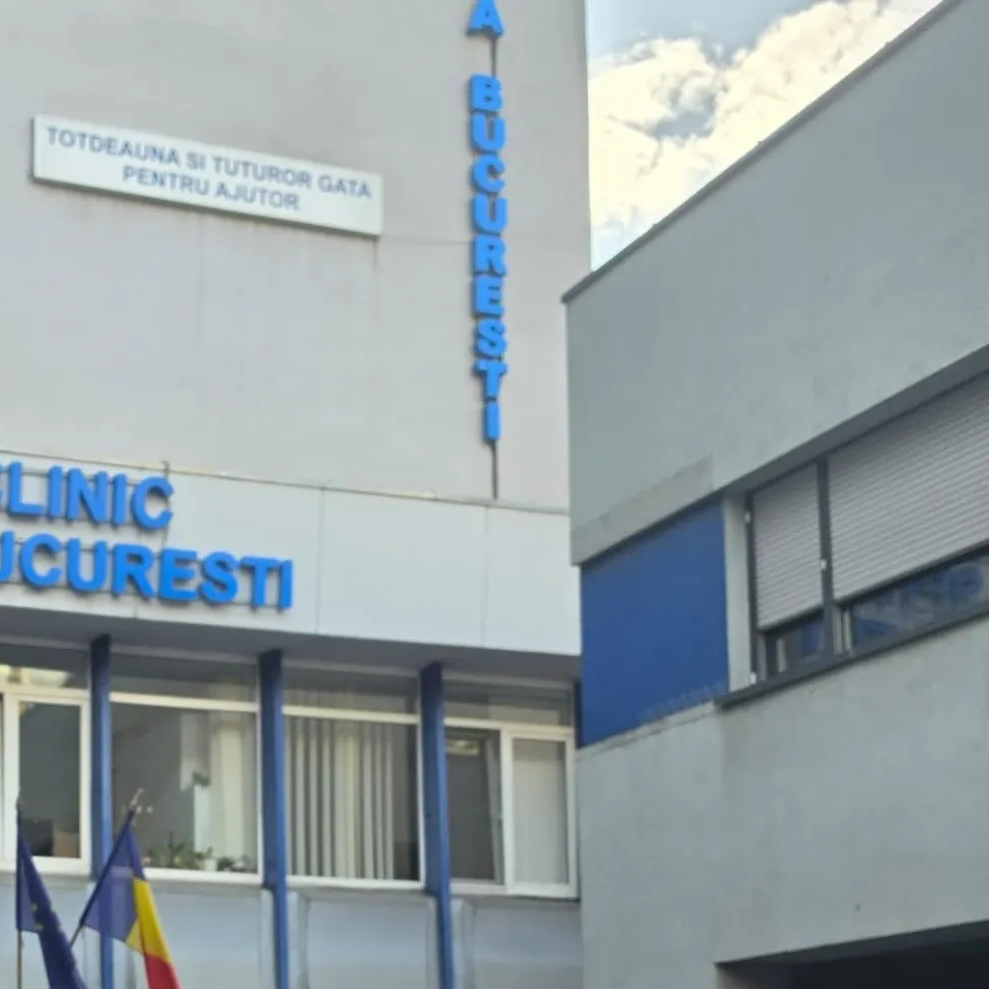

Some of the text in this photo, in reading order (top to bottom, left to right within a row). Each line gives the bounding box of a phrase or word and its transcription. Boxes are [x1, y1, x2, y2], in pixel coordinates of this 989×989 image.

[46, 126, 373, 200] TOTDEAUNA SI TUTUROR GATA
[122, 164, 300, 211] PENTRU AJUTOR
[468, 74, 507, 443] BUCURESTI
